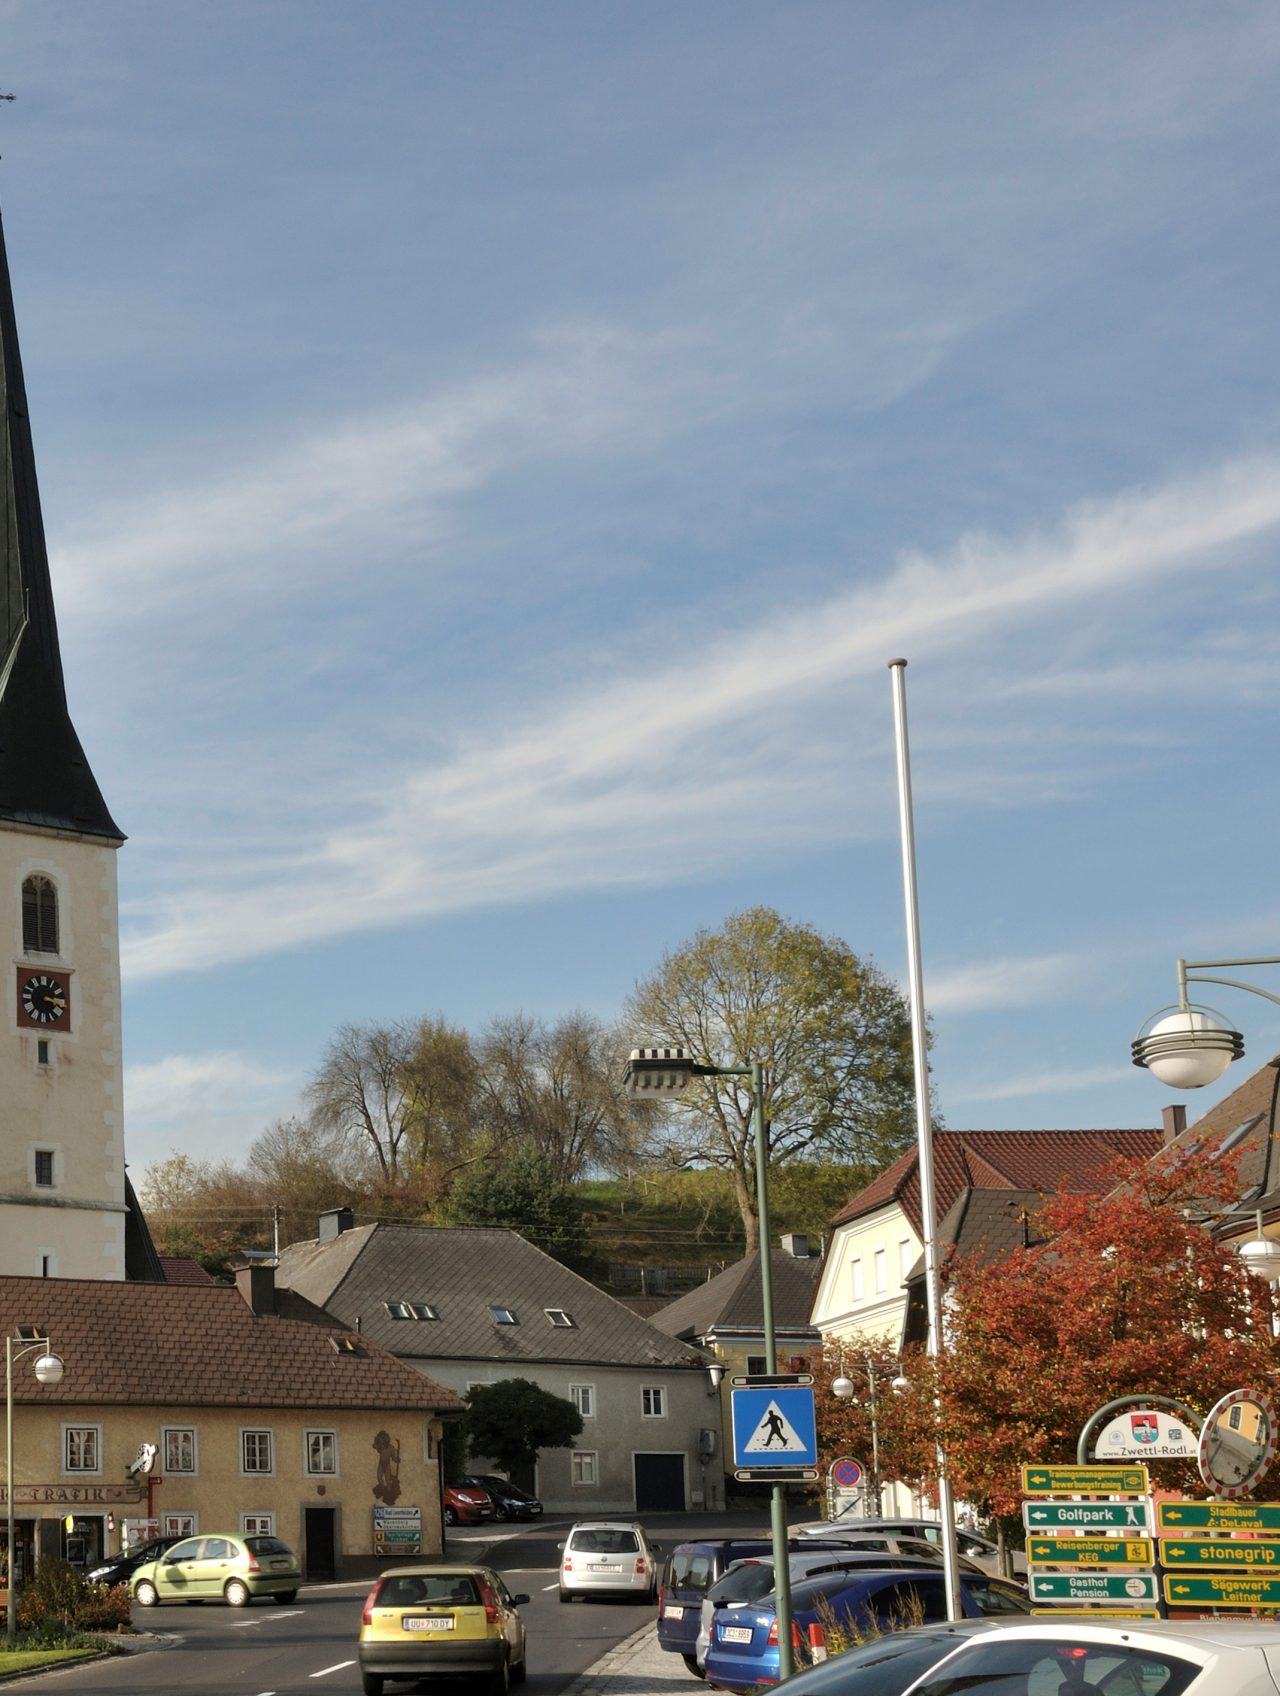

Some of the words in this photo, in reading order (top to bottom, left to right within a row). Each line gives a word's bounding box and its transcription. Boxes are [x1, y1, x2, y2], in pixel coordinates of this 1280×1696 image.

[1048, 1471, 1123, 1480] Trainingsmanagement
[1051, 1480, 1121, 1490] Bewerbungstraining
[30, 1488, 106, 1502] TRAFIK
[1058, 1509, 1114, 1522] Golfpark
[1210, 1507, 1257, 1517] Stadlbauer
[1220, 1519, 1263, 1528] DeLaval
[1055, 1541, 1120, 1552] Reisenberger
[1078, 1552, 1099, 1562] KEG
[1200, 1546, 1276, 1563] stonegrip
[1069, 1578, 1108, 1588] Gasthof
[1211, 1580, 1272, 1592] Sägewerk
[1070, 1588, 1109, 1598] Pension
[1222, 1592, 1263, 1602] Leitner
[426, 1620, 438, 1628] 710
[440, 1620, 449, 1628] DY
